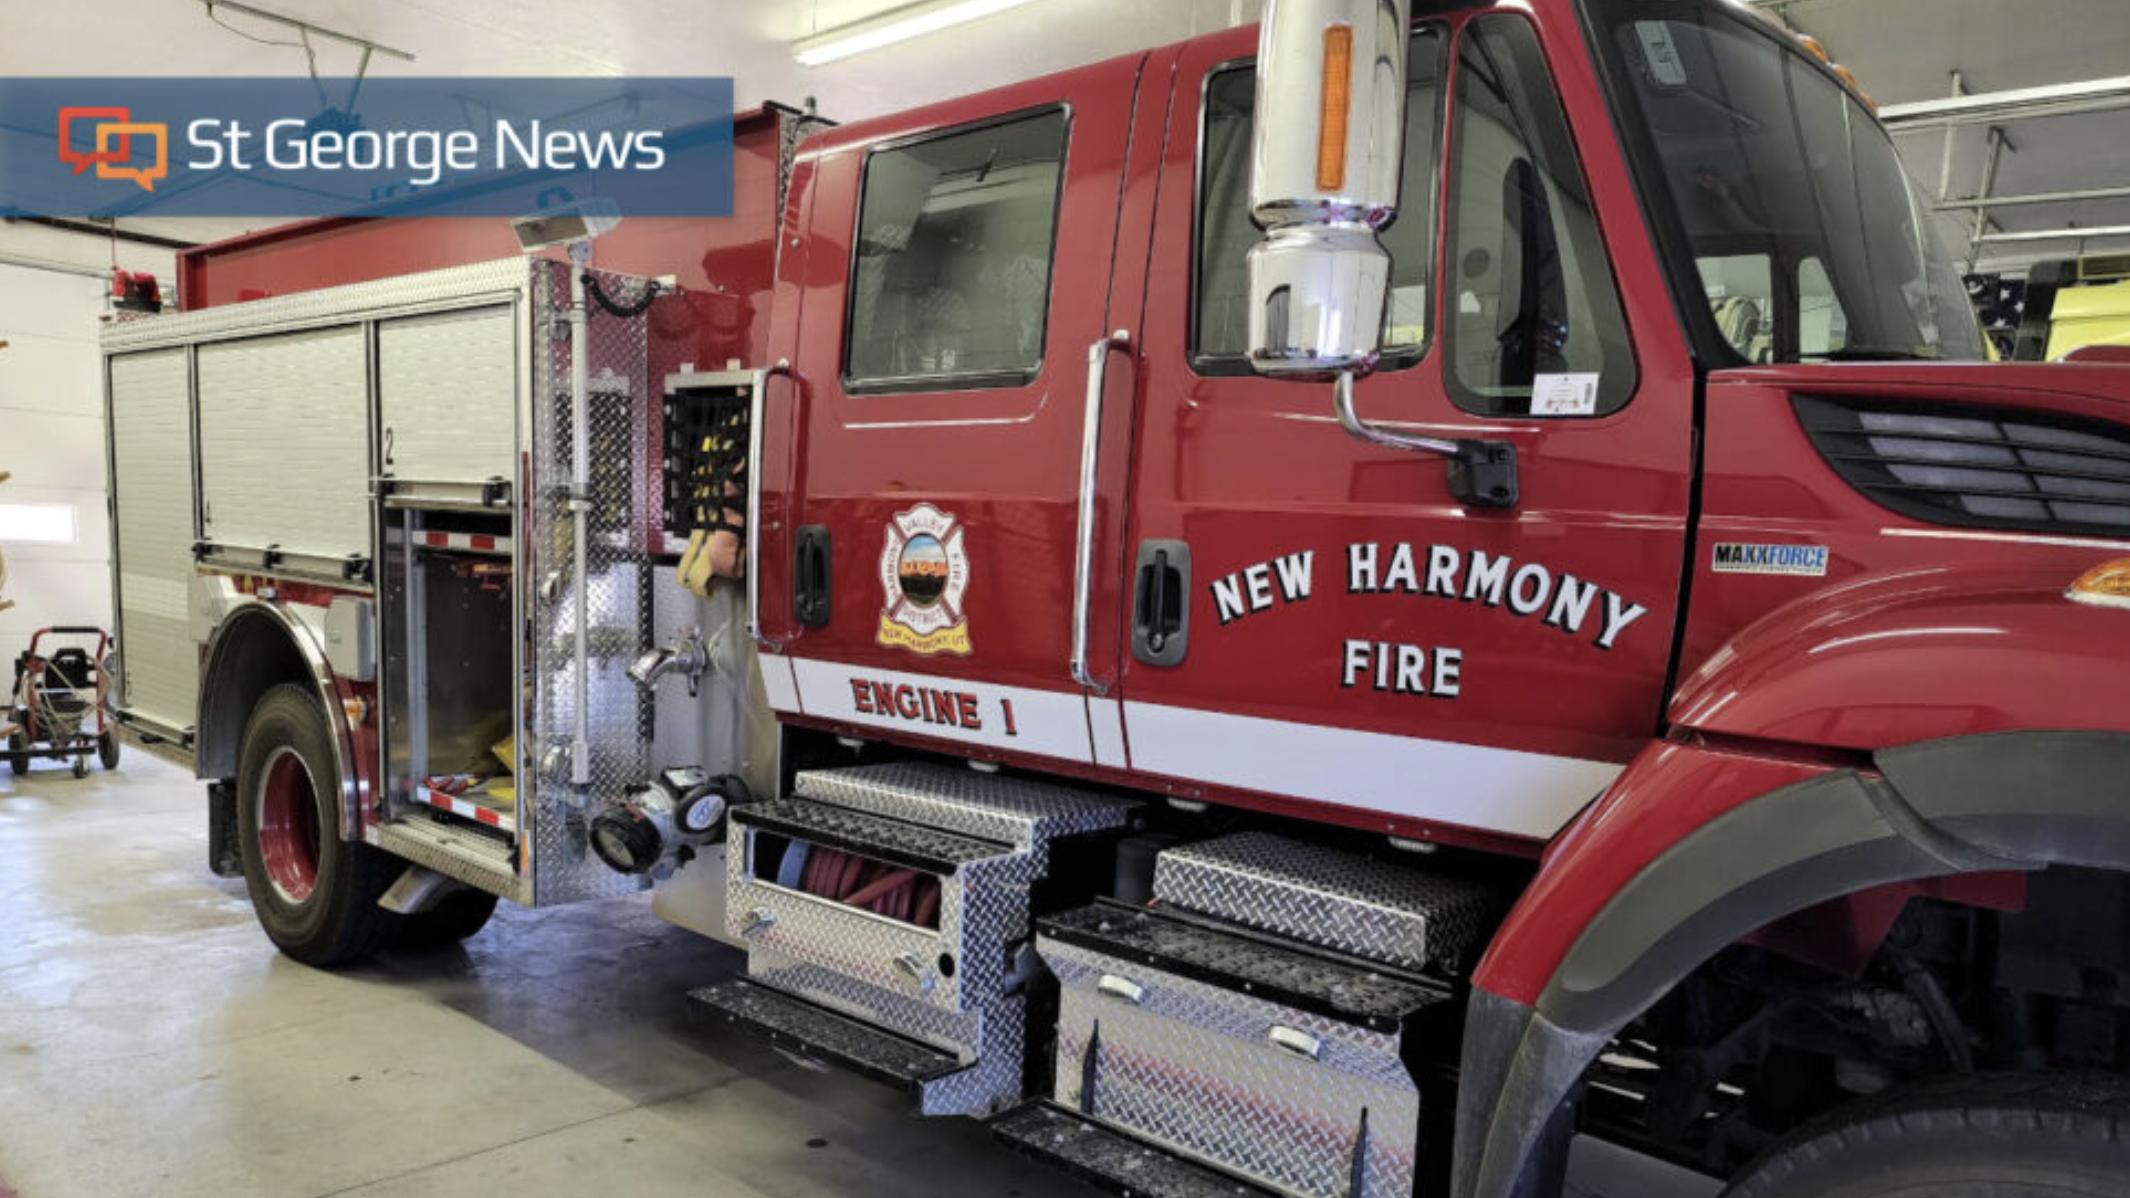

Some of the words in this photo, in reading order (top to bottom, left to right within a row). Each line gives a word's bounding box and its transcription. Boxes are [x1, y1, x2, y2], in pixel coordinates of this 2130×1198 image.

[385, 427, 394, 465] 2
[903, 514, 945, 532] VALLEY
[952, 552, 962, 591] FIRE
[1715, 544, 1826, 568] MAXXFORCE
[1210, 550, 1314, 625] NEW
[1346, 542, 1648, 648] HARMONY
[883, 626, 903, 641] NEW
[952, 633, 965, 647] UT
[1341, 638, 1462, 696] FIRE
[849, 678, 982, 730] ENGINE
[1000, 698, 1017, 736] 1
